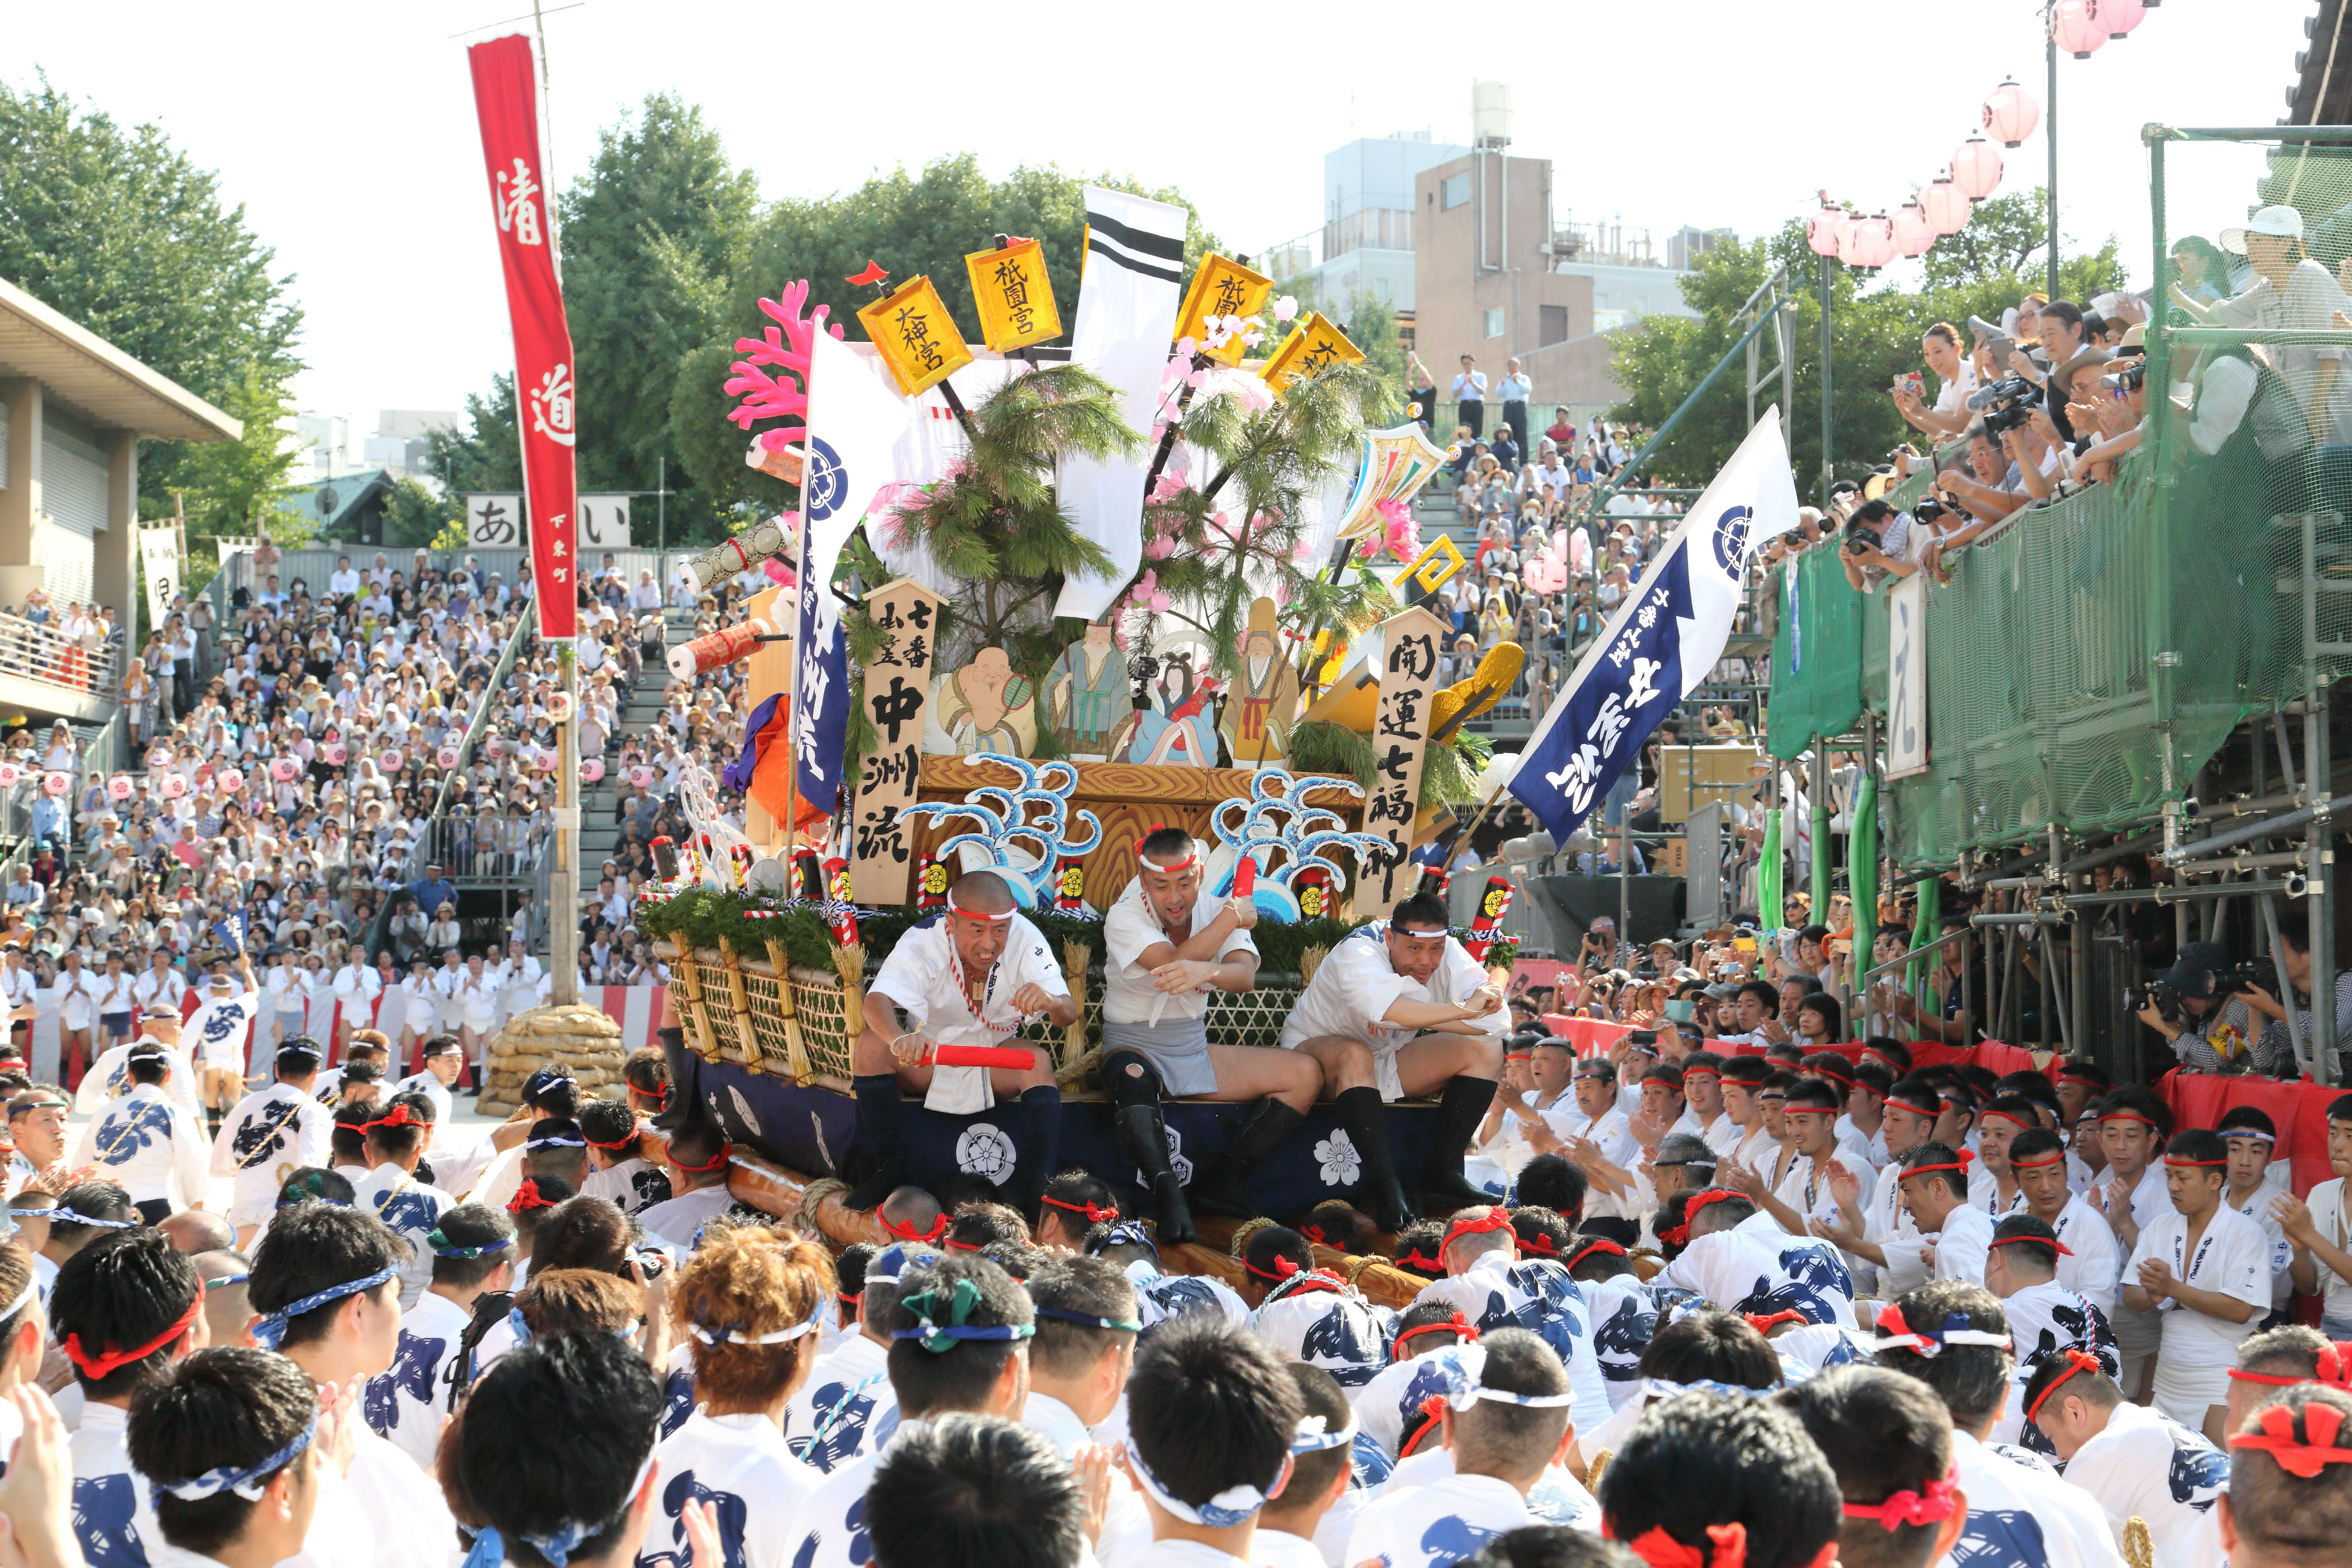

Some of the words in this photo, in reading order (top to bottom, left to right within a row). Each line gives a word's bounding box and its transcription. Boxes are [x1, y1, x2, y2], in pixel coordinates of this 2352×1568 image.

[496, 157, 576, 447] 清道
[993, 258, 1034, 335] 祇園宮
[1206, 274, 1245, 335] 祇園
[894, 306, 943, 372] 大神宮
[474, 500, 515, 543] あ
[550, 513, 569, 582] 下東町
[583, 504, 625, 543] い
[874, 601, 905, 667] 山笠
[903, 599, 933, 668] 七番
[1892, 600, 1915, 760] え
[857, 676, 924, 863] 中洲流
[1360, 634, 1436, 904] 開運七福神
